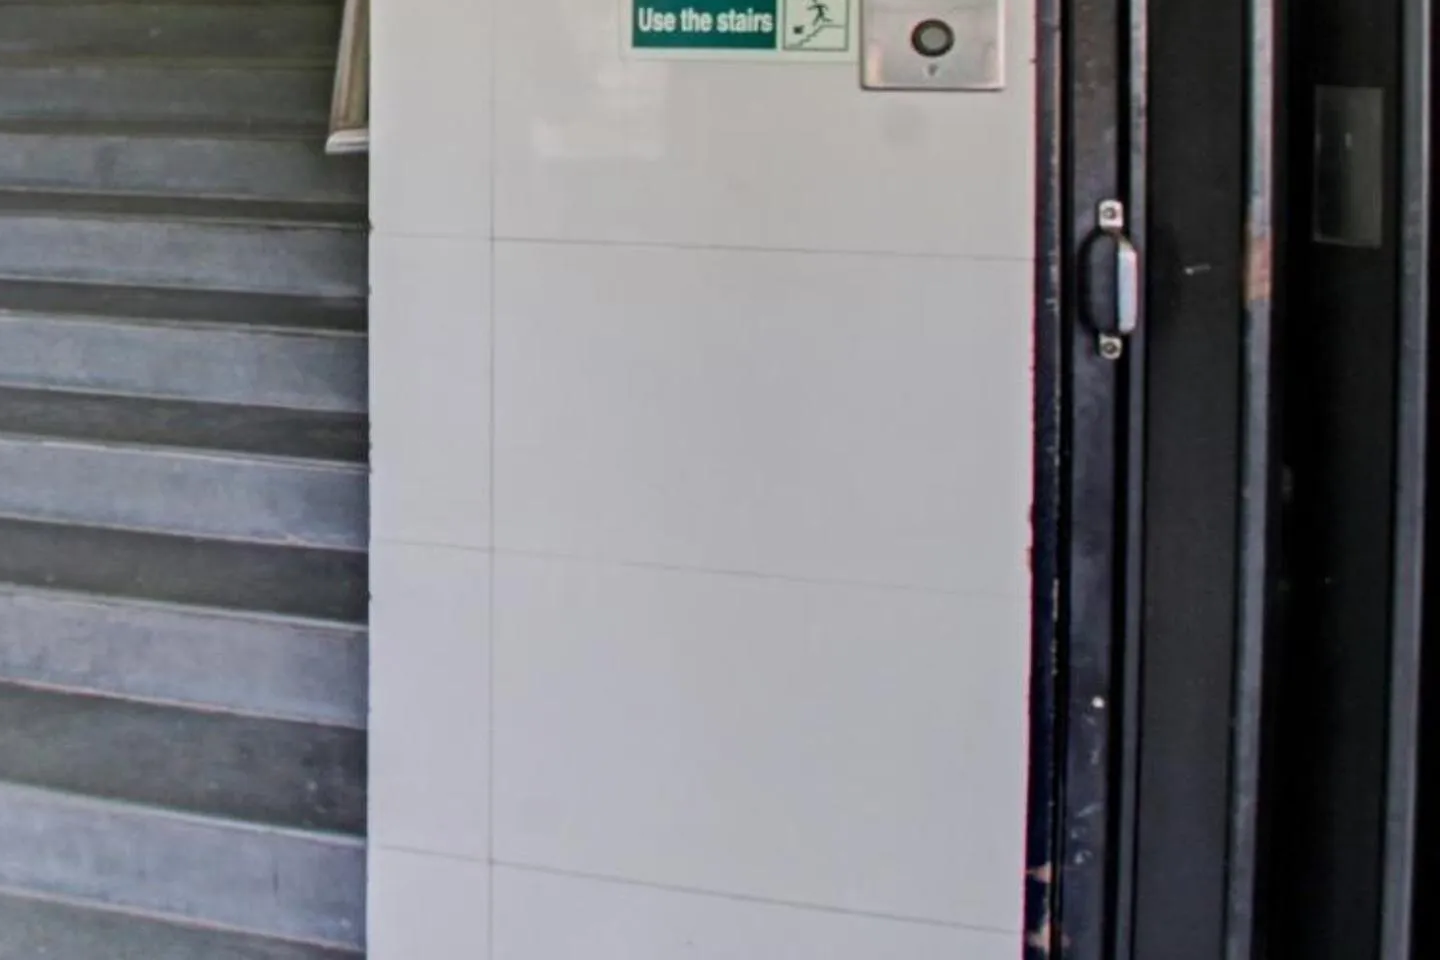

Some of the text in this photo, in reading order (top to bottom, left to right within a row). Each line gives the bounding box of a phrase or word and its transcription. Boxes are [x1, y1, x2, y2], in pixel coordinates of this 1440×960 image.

[637, 7, 773, 33] Use the stairs
